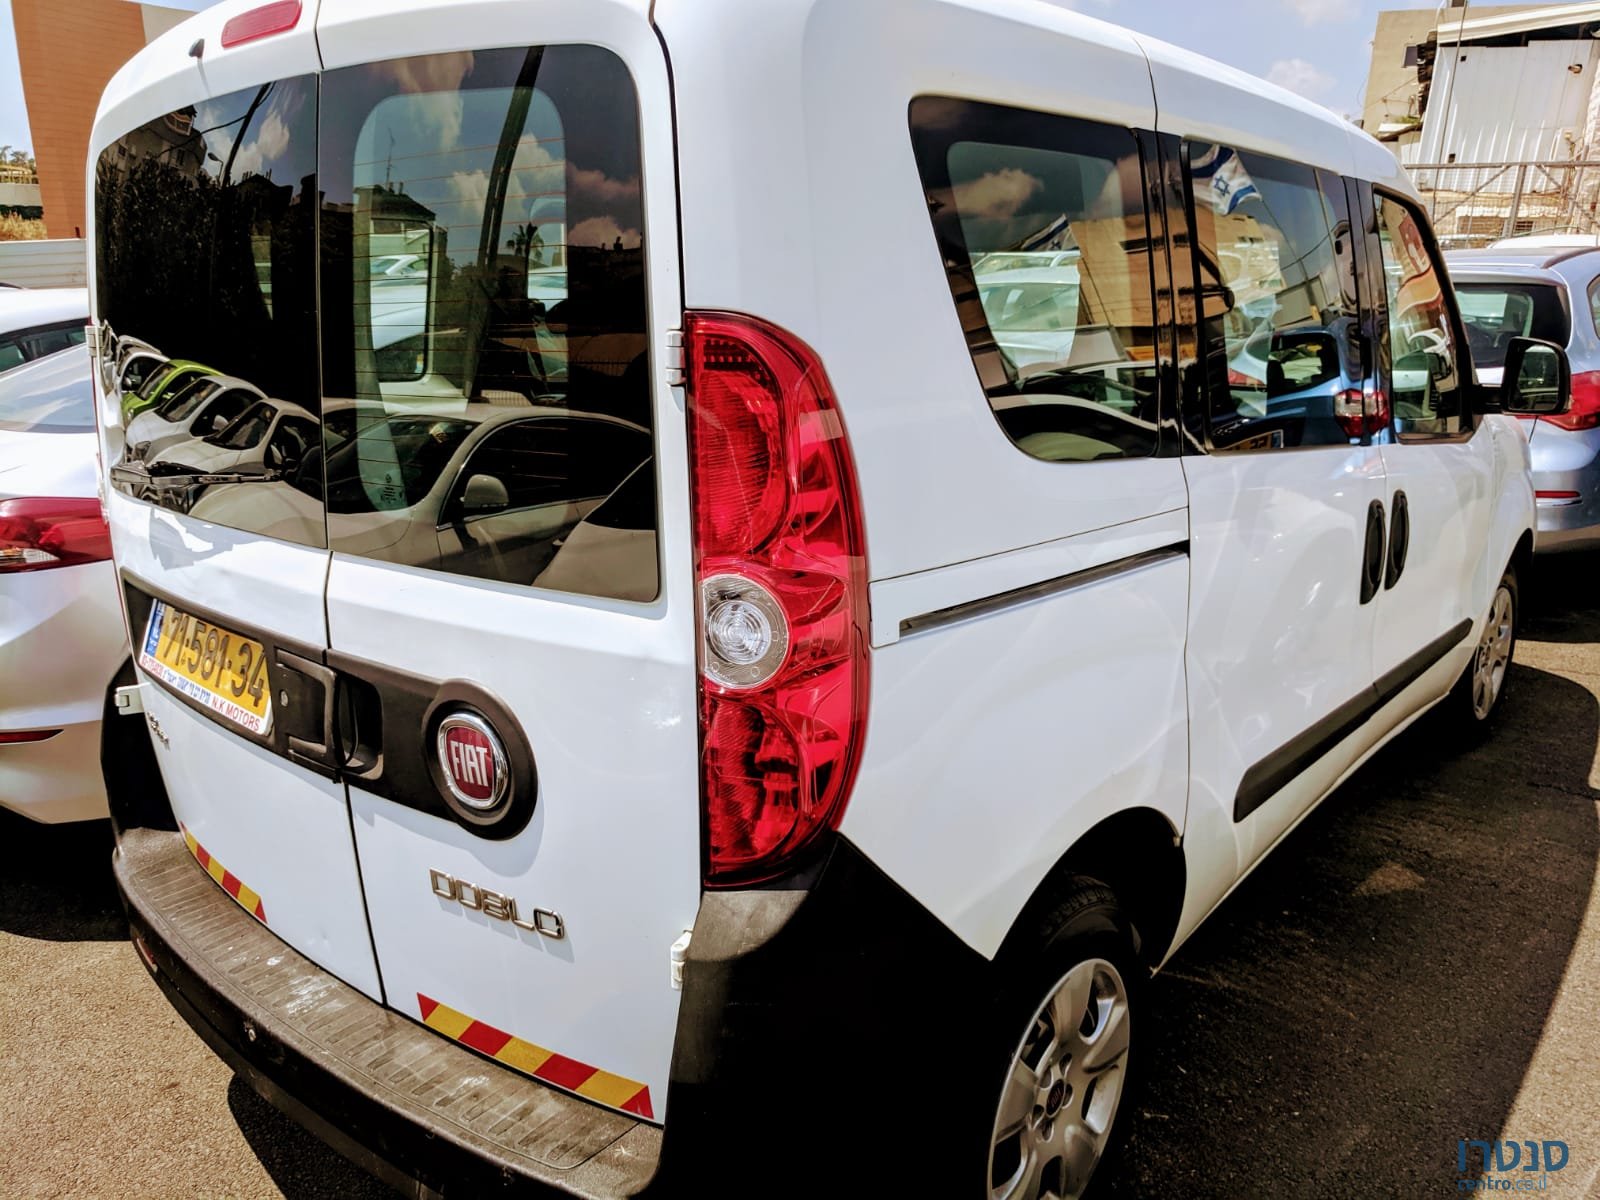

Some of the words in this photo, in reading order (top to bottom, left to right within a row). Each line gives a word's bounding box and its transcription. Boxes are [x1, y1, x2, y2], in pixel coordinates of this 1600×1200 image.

[225, 704, 261, 731] MOTORS
[450, 740, 488, 787] FIAT
[429, 867, 565, 940] DOBLO
